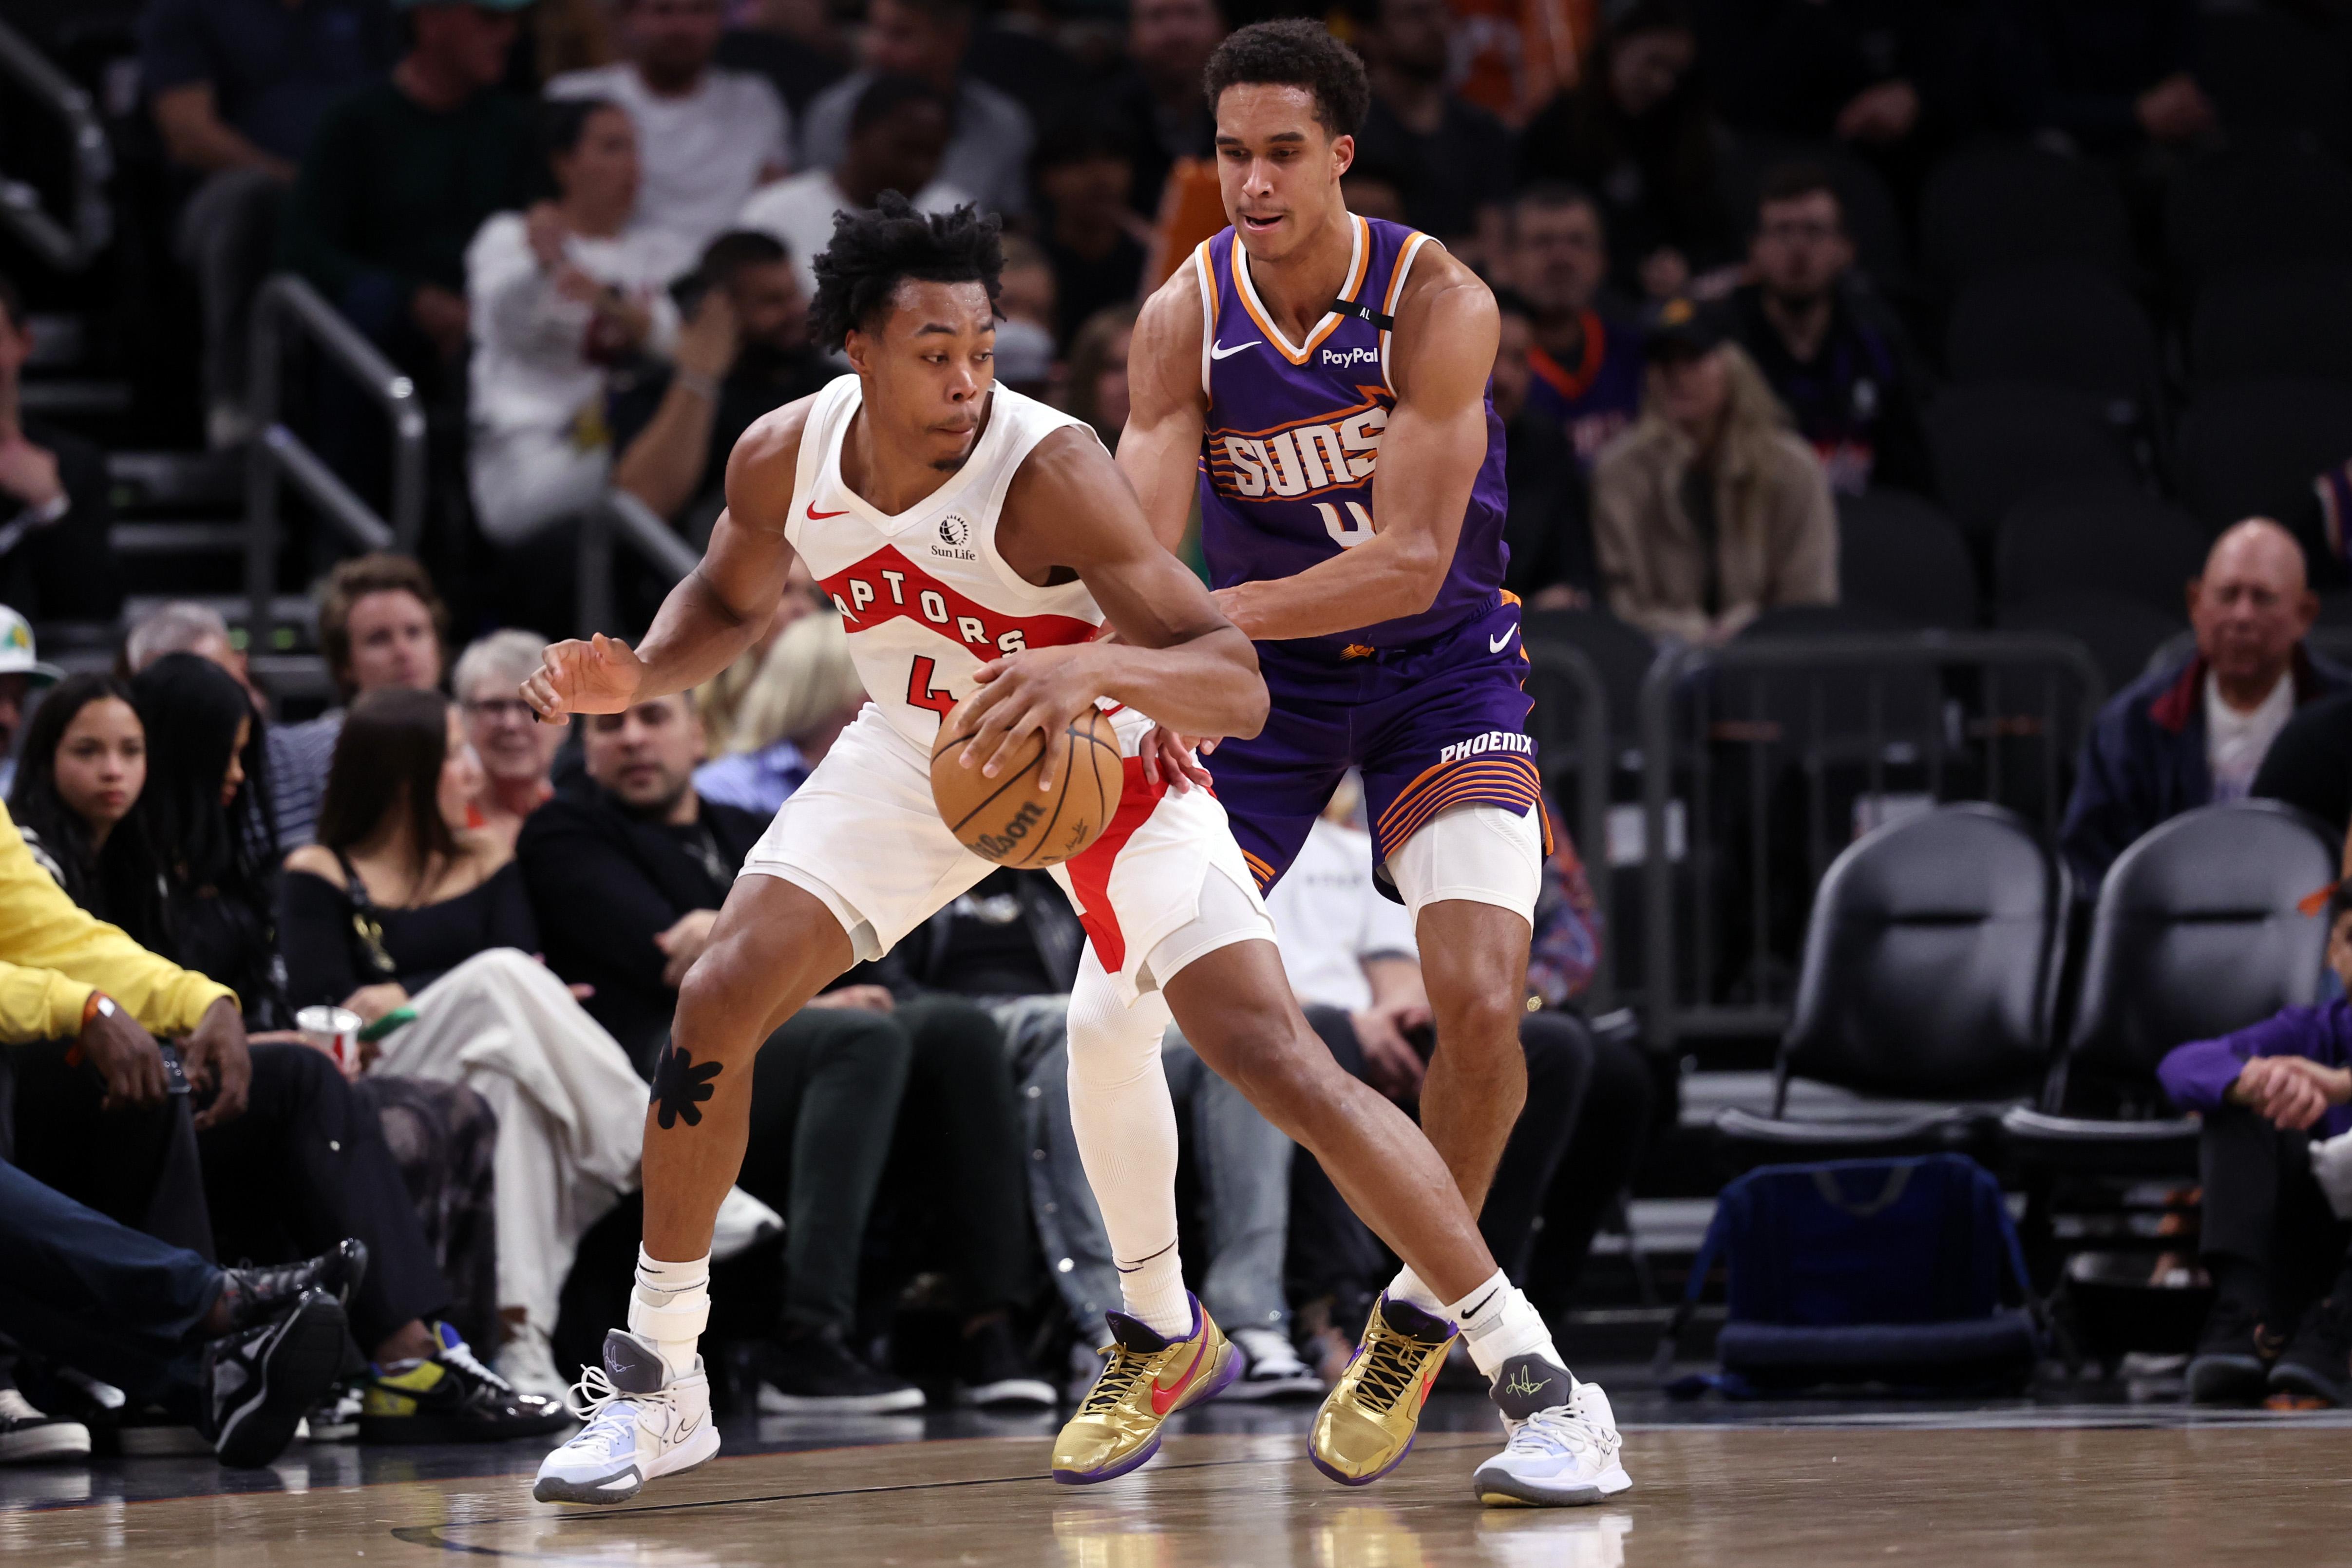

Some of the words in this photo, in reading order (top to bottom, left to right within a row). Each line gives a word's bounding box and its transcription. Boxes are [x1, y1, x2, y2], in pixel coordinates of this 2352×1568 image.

[1359, 307, 1370, 320] AL
[1323, 347, 1378, 368] PayPal
[1224, 407, 1388, 496] SUNS
[931, 545, 953, 558] Sun
[954, 548, 976, 561] Life
[906, 654, 959, 730] 4
[1441, 731, 1532, 764] PHOENIX
